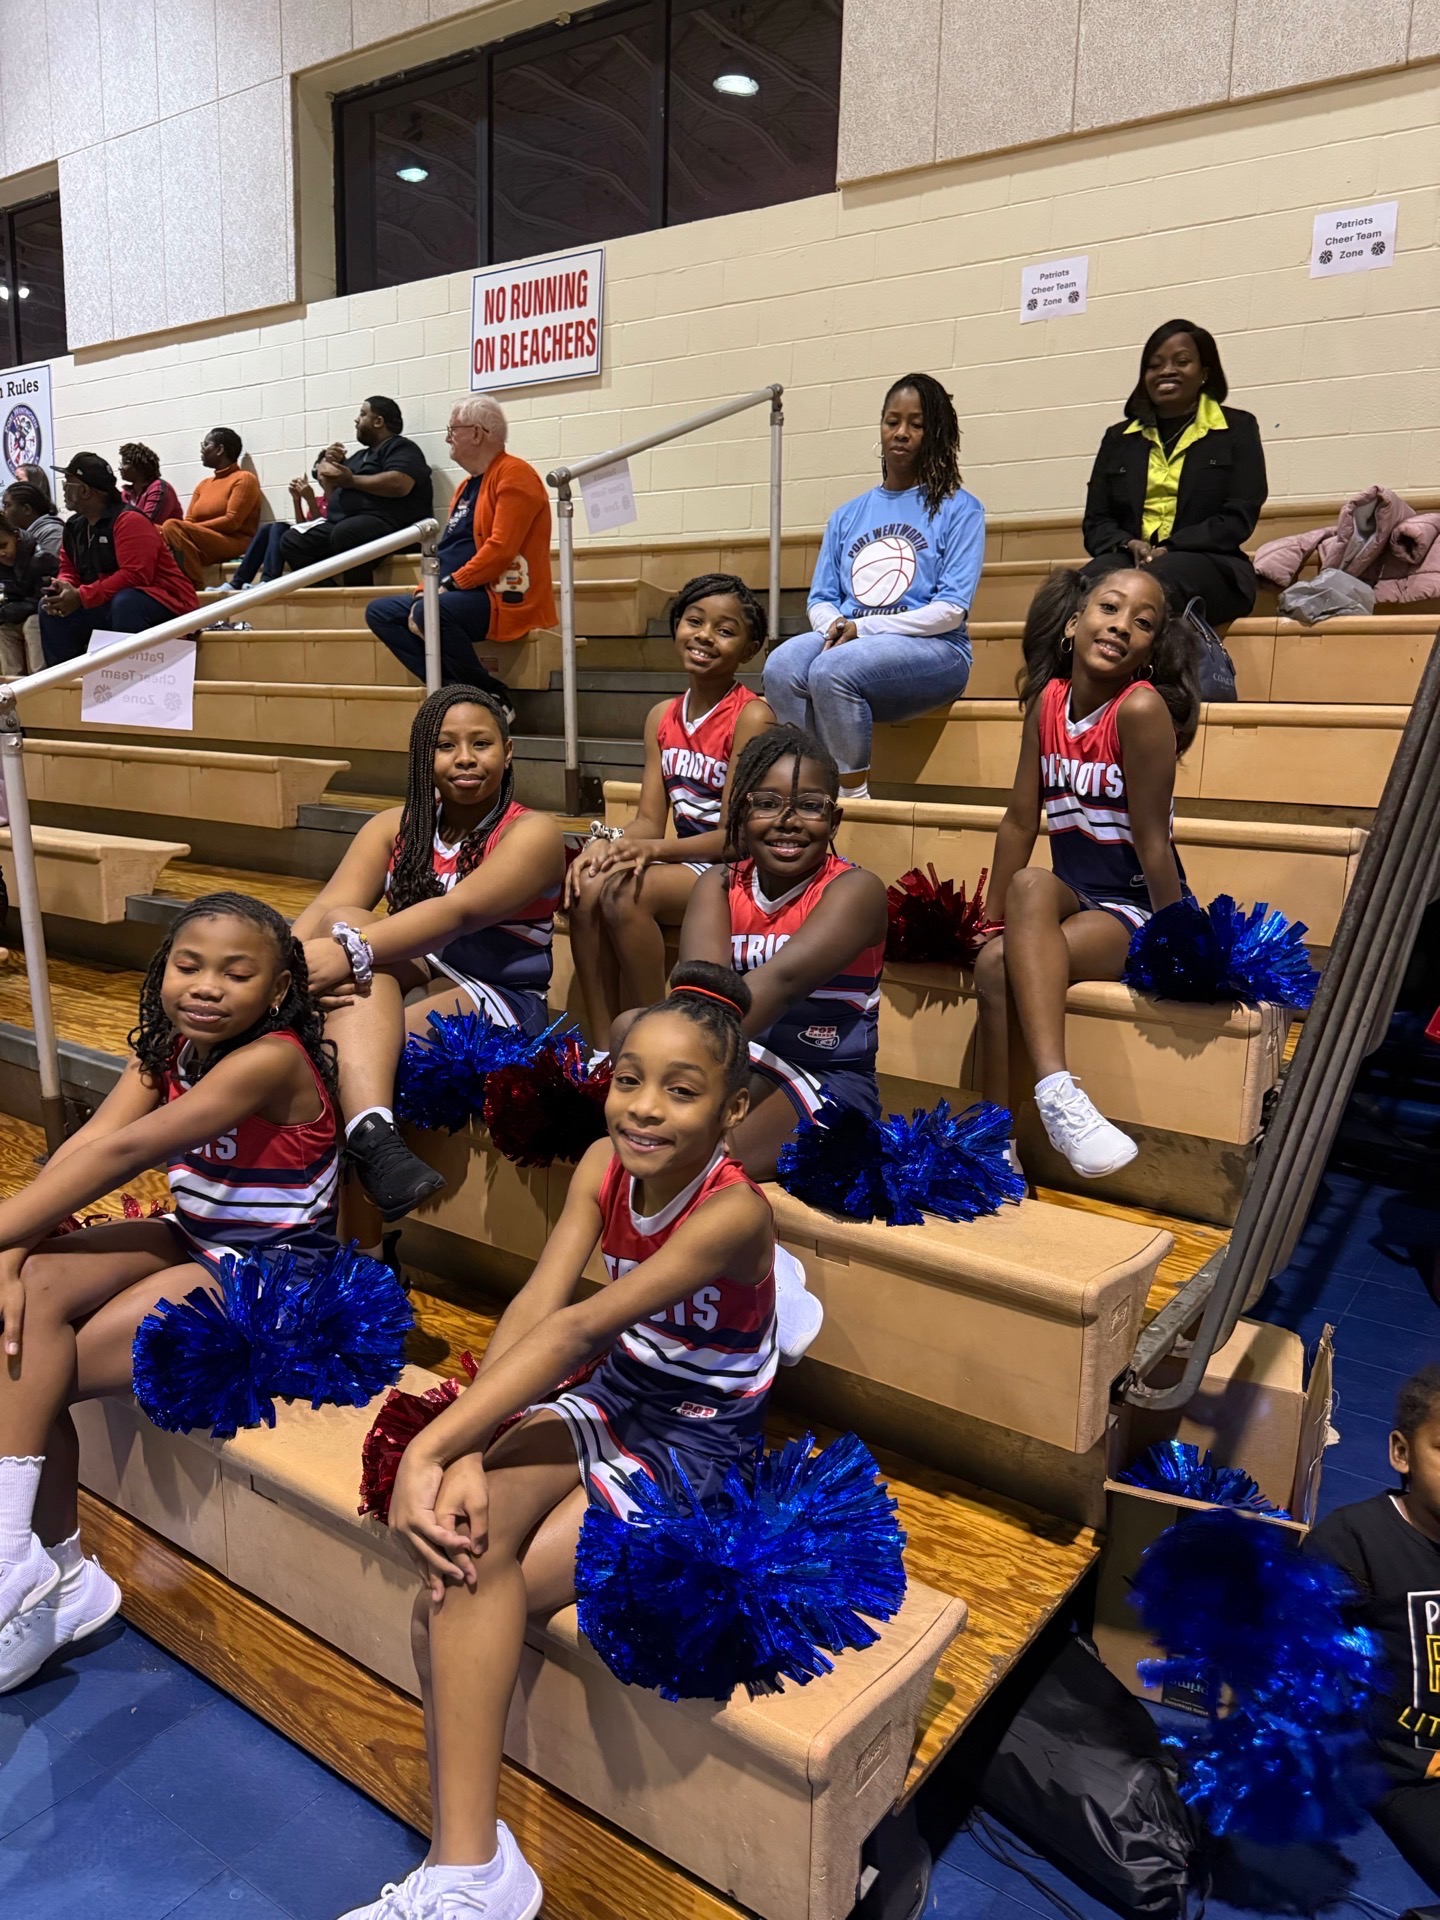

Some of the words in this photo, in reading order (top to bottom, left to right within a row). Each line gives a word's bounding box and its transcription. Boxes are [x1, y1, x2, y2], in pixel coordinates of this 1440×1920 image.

[1335, 217, 1374, 230] Patriots
[1325, 235, 1354, 246] Cheer
[1356, 230, 1382, 241] Team
[1339, 249, 1364, 259] Zone
[1039, 269, 1070, 281] Patriots
[1031, 286, 1055, 295] Cheer
[1056, 281, 1077, 290] Team
[484, 286, 506, 326] NO
[510, 269, 588, 321] RUNNING
[1043, 297, 1063, 307] Zone
[474, 336, 495, 375] ON
[500, 318, 597, 371] BLEACHERS
[7, 378, 39, 397] Rules
[847, 532, 871, 559] PORT
[872, 523, 929, 552] WENTWORTH
[809, 1026, 836, 1034] POP
[683, 1402, 716, 1417] POP
